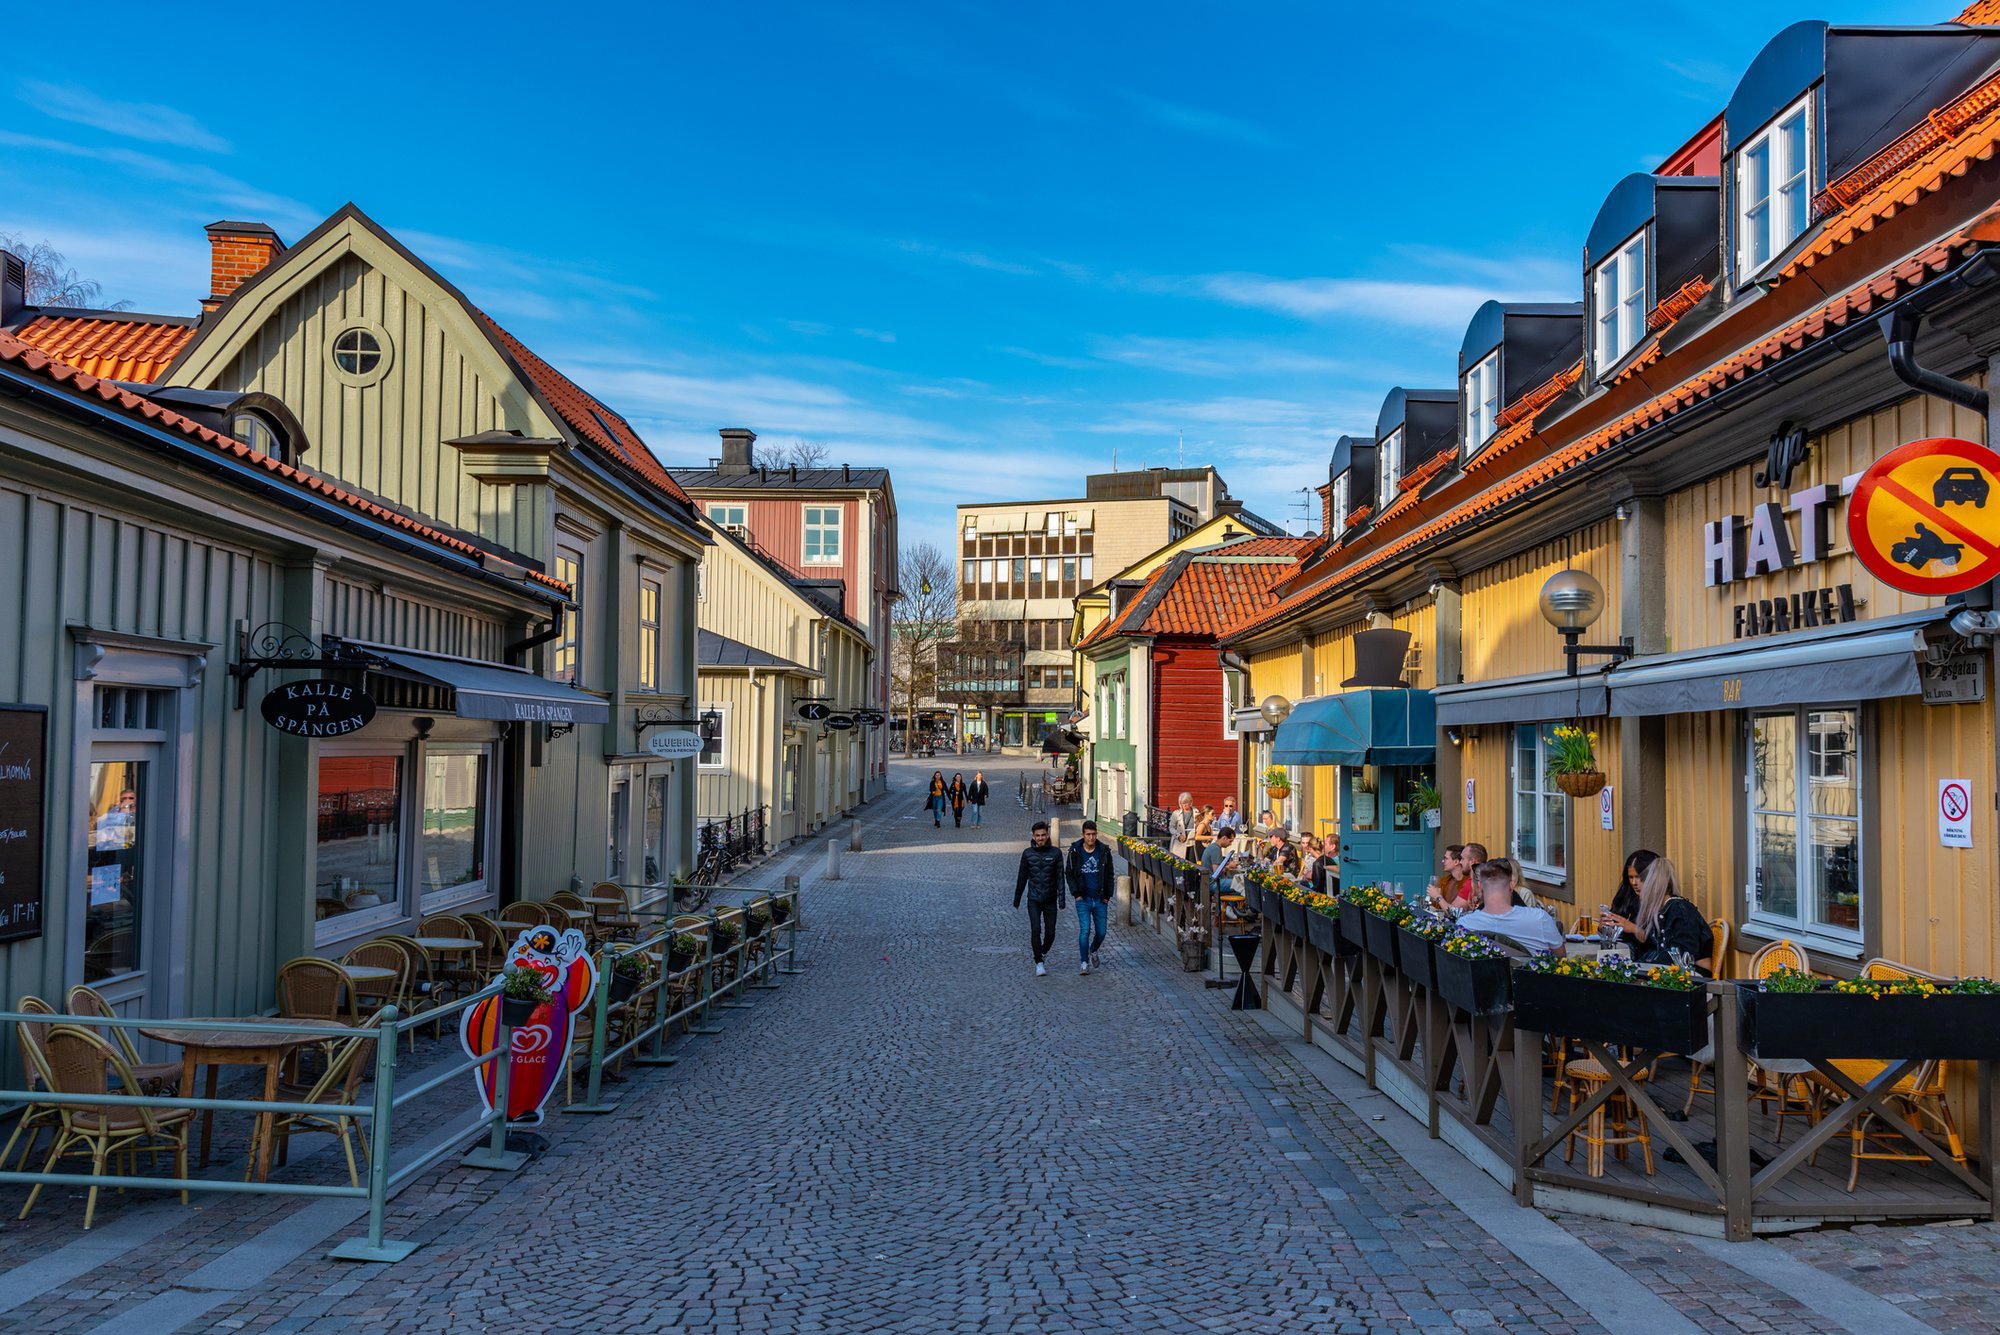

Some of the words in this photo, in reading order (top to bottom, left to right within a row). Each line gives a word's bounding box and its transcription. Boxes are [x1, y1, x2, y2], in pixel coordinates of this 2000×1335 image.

[1704, 470, 1868, 588] HAT
[1734, 584, 1856, 639] FABRIKEN
[287, 683, 352, 700] KALLE
[1724, 679, 1741, 704] BAR
[1972, 679, 1978, 696] 1
[307, 702, 330, 716] PÅ
[515, 704, 535, 719] KALLE
[536, 701, 546, 720] PÅ
[547, 702, 573, 722] SPÅNGEN
[809, 705, 820, 719] K
[275, 715, 364, 736] SPÅNGEN
[652, 737, 700, 748] BLUEBIRD
[516, 1055, 547, 1063] GLACE
